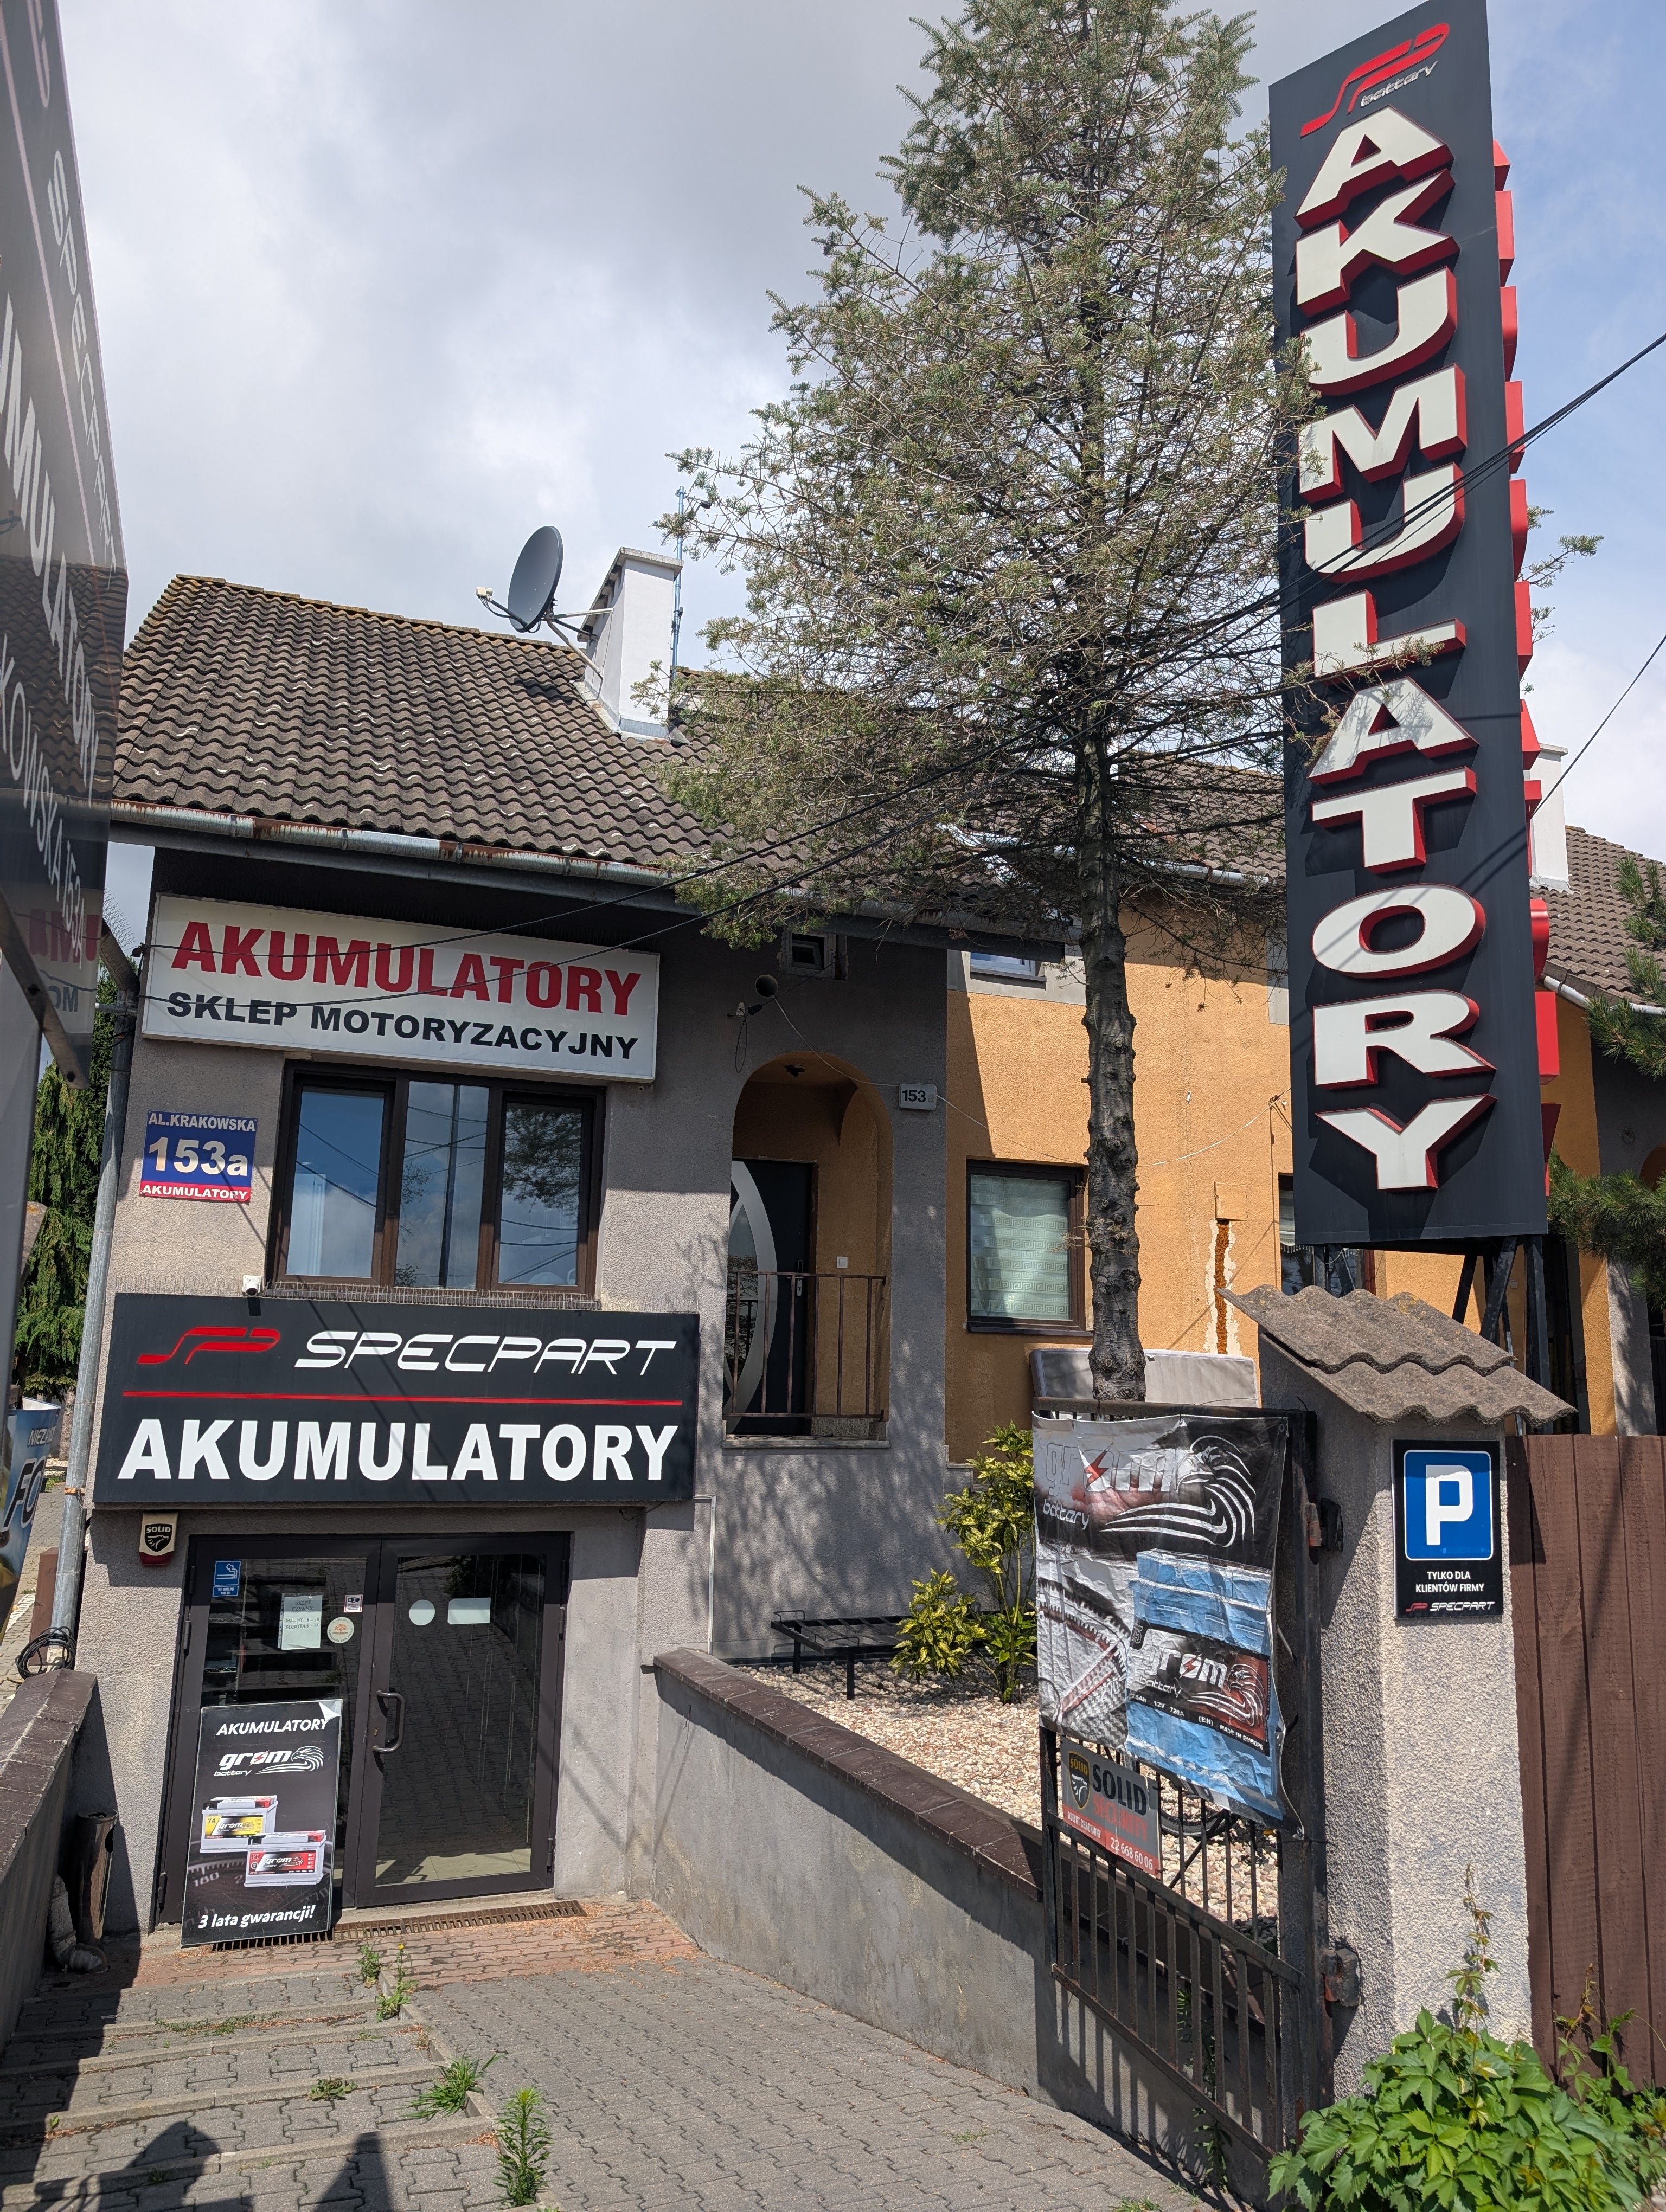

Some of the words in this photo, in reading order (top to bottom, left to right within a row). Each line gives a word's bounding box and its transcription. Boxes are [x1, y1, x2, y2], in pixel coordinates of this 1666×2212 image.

[1293, 104, 1497, 1193] AKUMULATORY
[171, 921, 642, 1016] AKUMULATORY
[166, 992, 298, 1026] SKLEP
[311, 1007, 639, 1059] MOTORYZACYJNY
[149, 1137, 248, 1177] 153a
[143, 1185, 248, 1200] AKUMULATORY
[294, 1330, 677, 1375] SPECPART
[117, 1418, 679, 1482] AKUMULATORY
[1043, 1499, 1090, 1530] battery
[1426, 1464, 1473, 1546] P
[1415, 1581, 1458, 1593] KLIENTÓW
[1459, 1583, 1485, 1592] FIRMY
[1427, 1571, 1453, 1580] TYLKO
[1455, 1571, 1471, 1580] DLA
[1430, 1601, 1495, 1612] SPECPART
[1139, 1674, 1183, 1698] battery
[216, 1719, 326, 1735] AKUMULATORY
[1154, 1700, 1165, 1709] 12V
[1170, 1707, 1185, 1717] 720A
[1198, 1715, 1214, 1726] (EN)
[1220, 1724, 1234, 1736] MADE
[1242, 1735, 1264, 1751] EUROPE
[1070, 1758, 1088, 1776] SOLID
[1092, 1764, 1147, 1816] SOLID
[1092, 1793, 1148, 1842] SECURITY
[1120, 1843, 1133, 1859] 668
[1135, 1850, 1143, 1864] 60
[1144, 1855, 1153, 1870] 06
[198, 1915, 209, 1928] 3
[210, 1913, 239, 1927] lata
[240, 1905, 316, 1928] gwarancji!
